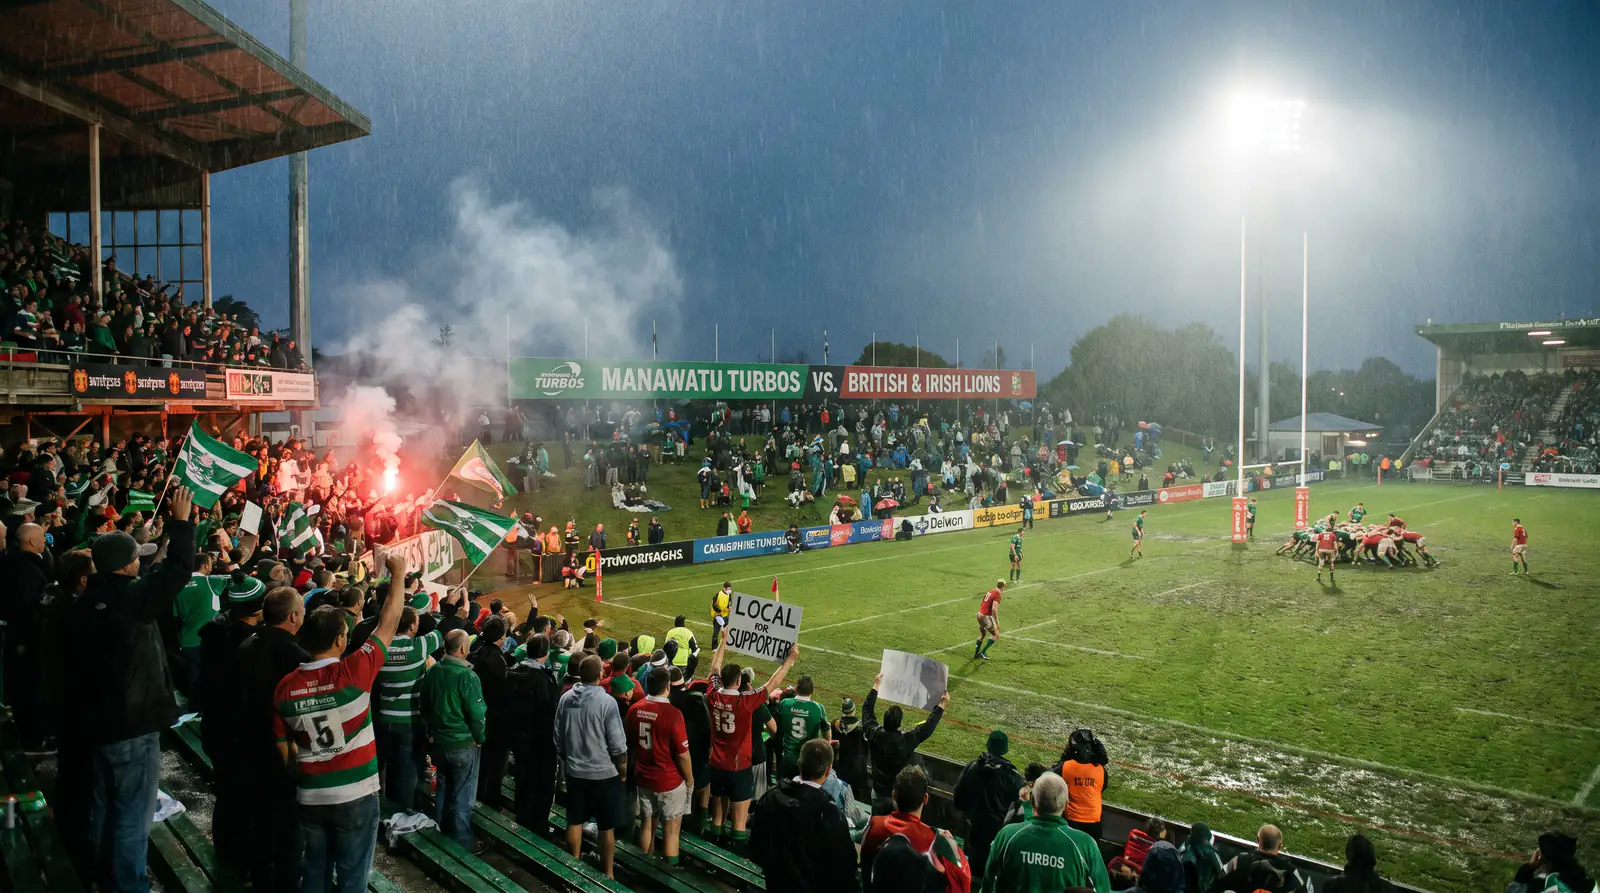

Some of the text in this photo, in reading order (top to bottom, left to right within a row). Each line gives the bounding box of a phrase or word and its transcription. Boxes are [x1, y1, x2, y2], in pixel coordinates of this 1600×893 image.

[535, 377, 585, 389] TURBOS
[602, 367, 1001, 393] MANAWATU TURBOS VS. BRITISH & IRISH LIONS
[735, 596, 796, 629] LOCAL
[754, 622, 769, 633] FOR
[725, 627, 796, 660] SUPPORTER
[311, 714, 335, 748] 5
[713, 709, 736, 734] 13
[791, 717, 807, 739] 3
[638, 721, 652, 750] 5
[1020, 850, 1065, 869] TURBOS
